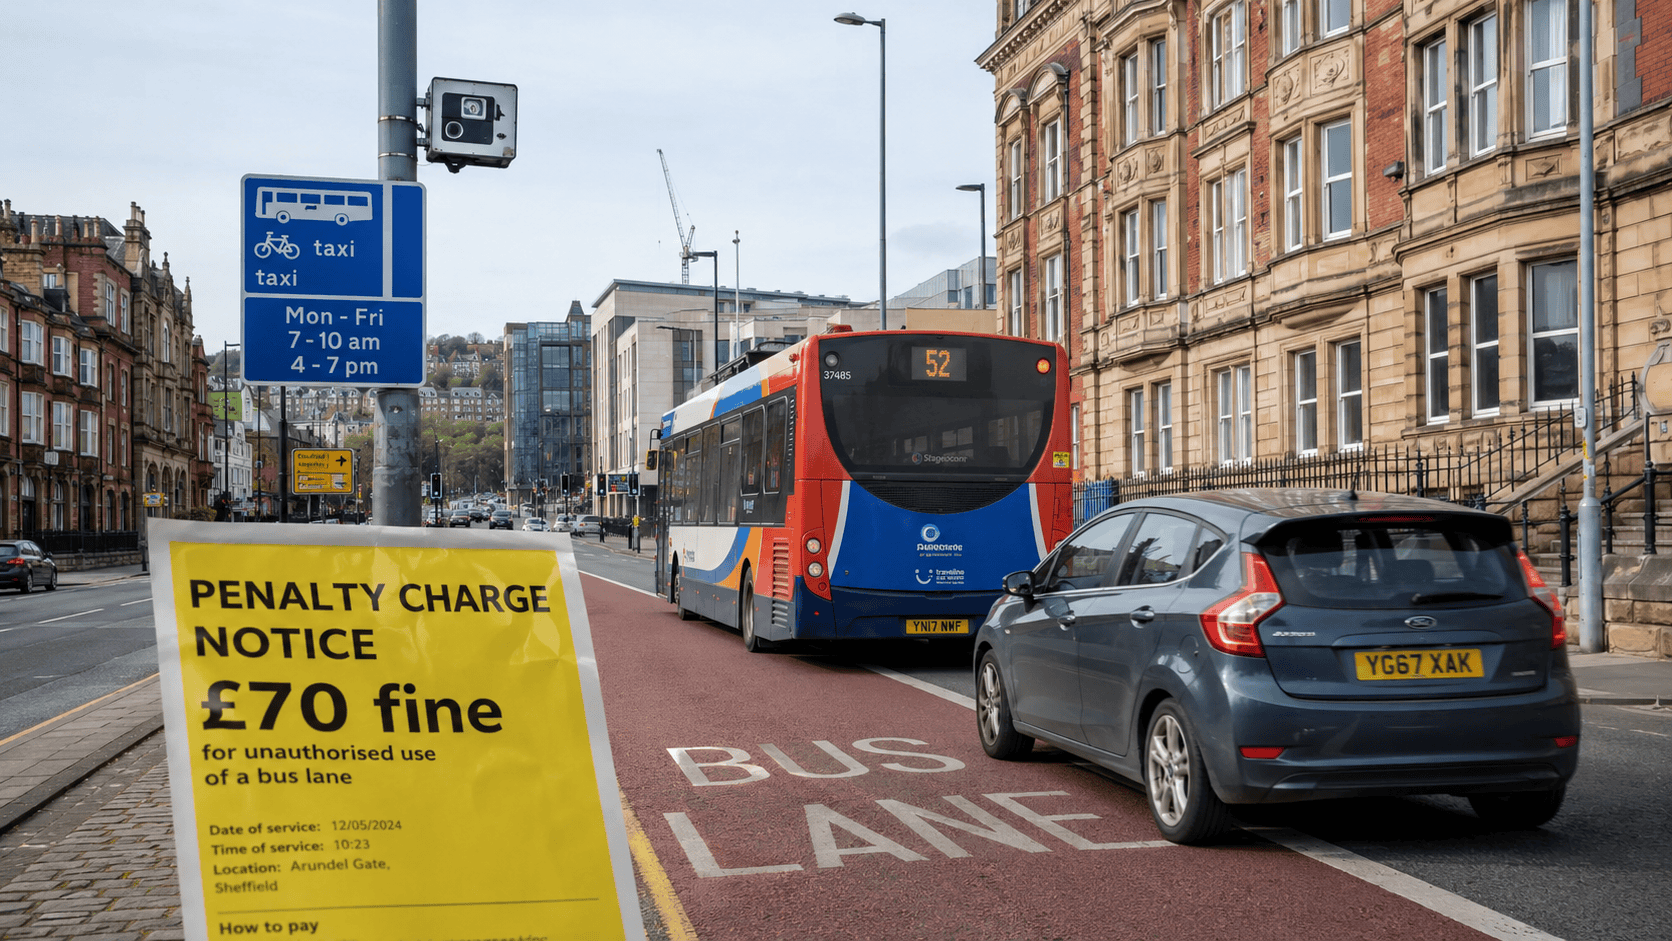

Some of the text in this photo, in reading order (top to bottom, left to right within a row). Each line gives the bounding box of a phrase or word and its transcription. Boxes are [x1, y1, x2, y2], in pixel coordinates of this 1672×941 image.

[313, 239, 355, 257] taxi
[255, 269, 298, 286] taxi
[286, 306, 333, 325] Mon
[355, 308, 384, 326] Fri
[348, 337, 380, 350] am
[345, 361, 378, 378] pm
[925, 349, 951, 378] 52
[824, 370, 852, 380] 37485
[189, 579, 551, 613] PENALTY CHARGE
[194, 626, 378, 660] NOTICE
[1365, 651, 1474, 677] YG67 XAK
[201, 679, 503, 734] £70 fine
[202, 744, 436, 761] for unauthorised use
[665, 736, 967, 787] BUS
[205, 767, 352, 786] of a bus lane
[209, 819, 402, 836] Date of service: 12/05/2024
[662, 790, 1179, 880] LANE
[211, 839, 371, 856] Time of service: 10:23
[213, 858, 391, 876] Location: Arundel Gate,
[215, 880, 279, 894] Sheffield
[219, 922, 319, 936] How to pay
